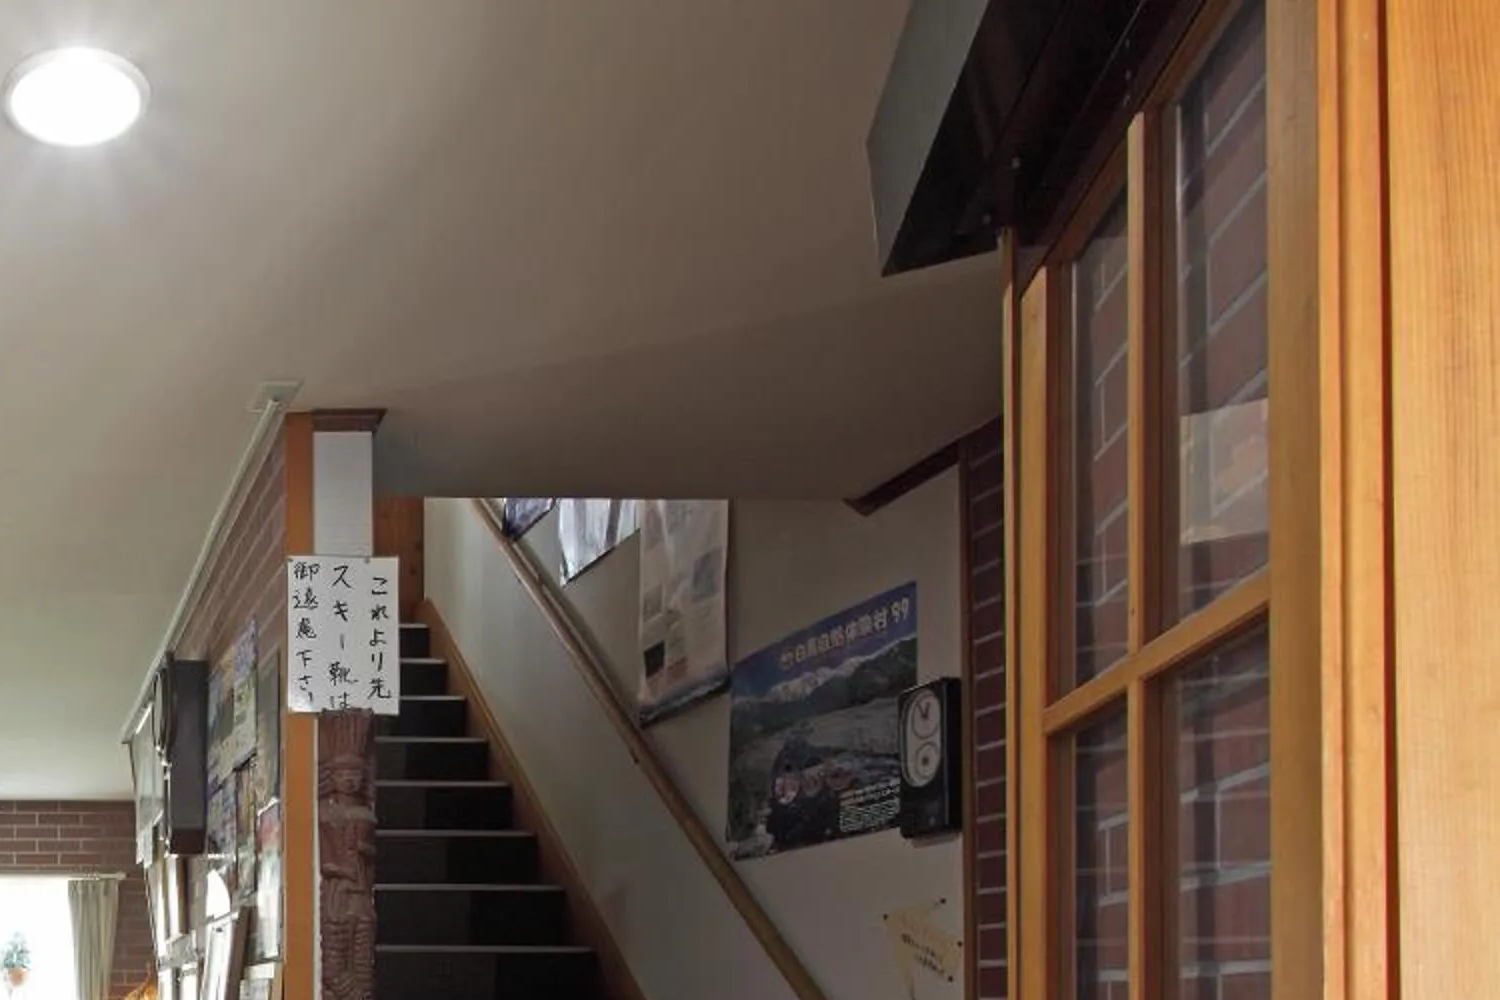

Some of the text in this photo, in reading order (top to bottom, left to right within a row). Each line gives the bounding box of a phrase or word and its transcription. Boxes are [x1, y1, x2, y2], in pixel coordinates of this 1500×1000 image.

[328, 564, 358, 709] スキー靴は
[367, 576, 391, 699] これより先
